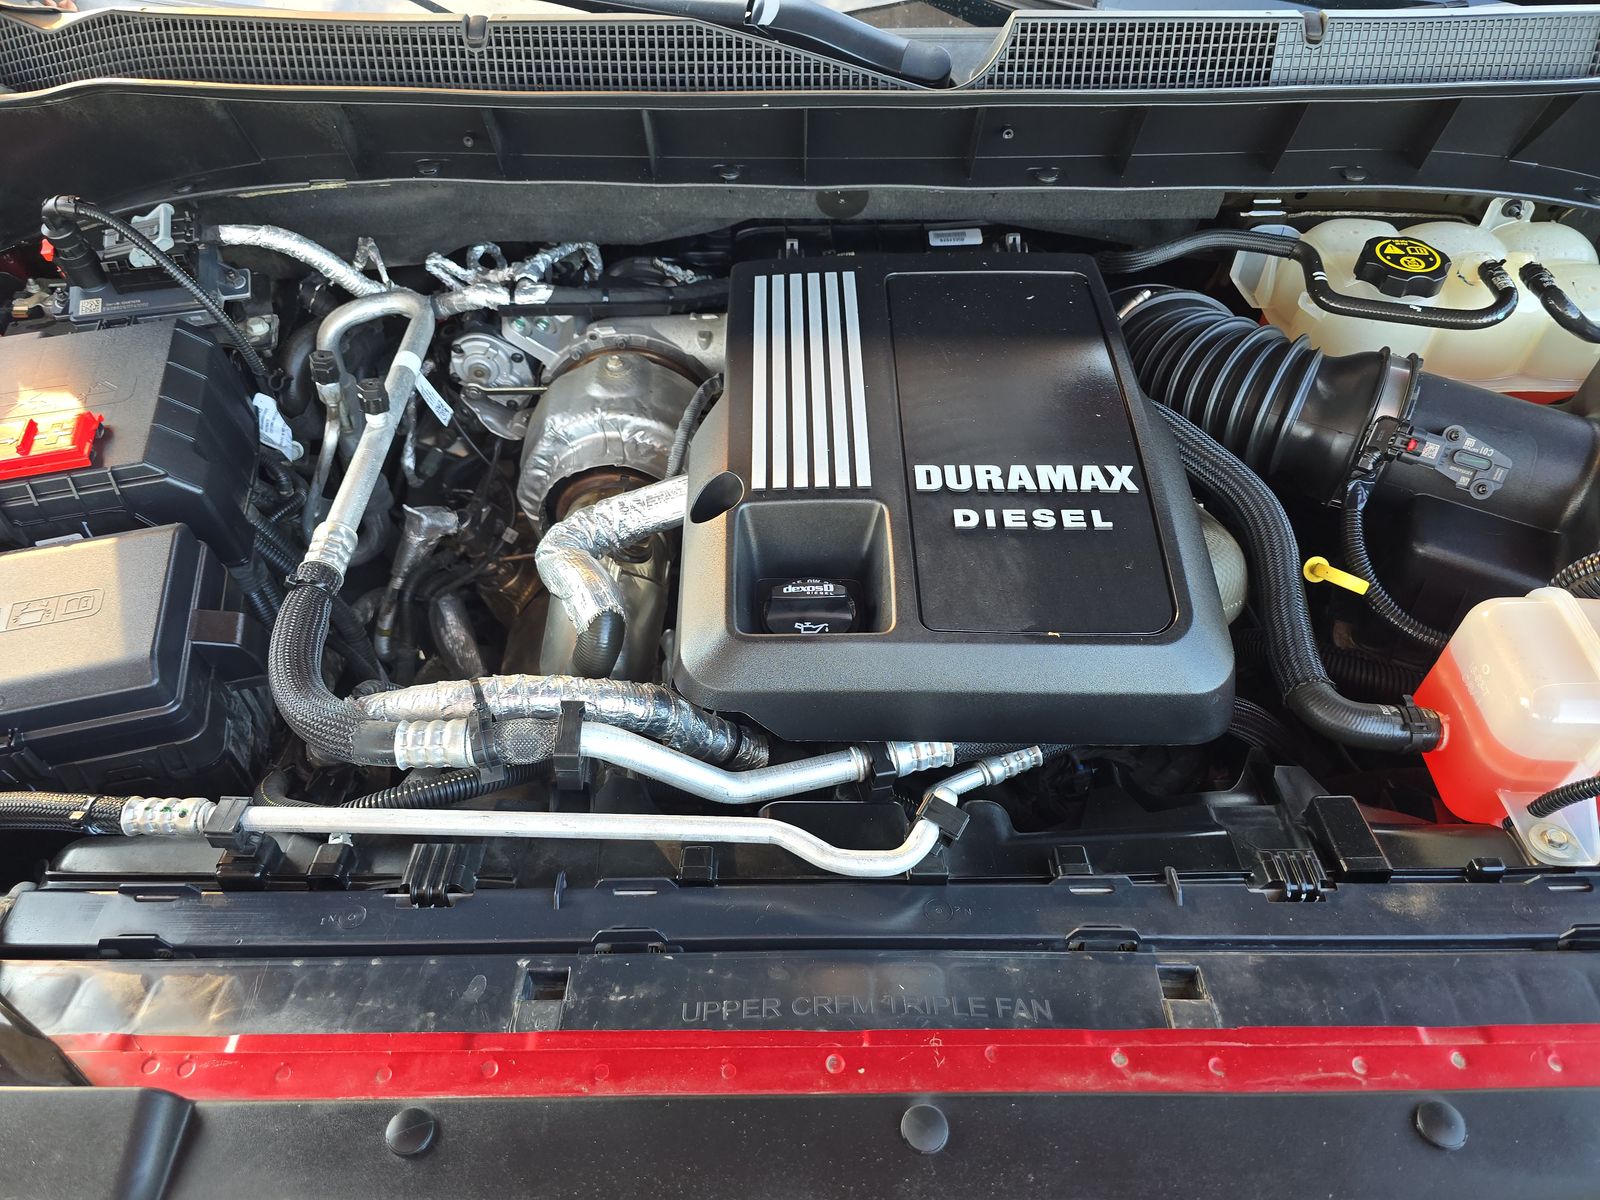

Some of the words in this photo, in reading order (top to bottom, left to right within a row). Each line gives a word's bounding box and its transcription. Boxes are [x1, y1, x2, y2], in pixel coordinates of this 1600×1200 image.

[914, 465, 1139, 493] DURAMAX
[953, 508, 1113, 530] DIESEL
[681, 998, 783, 1022] UPPER
[791, 995, 876, 1018] CRFM
[889, 995, 990, 1018] TRIPLE
[995, 996, 1054, 1021] FAN
